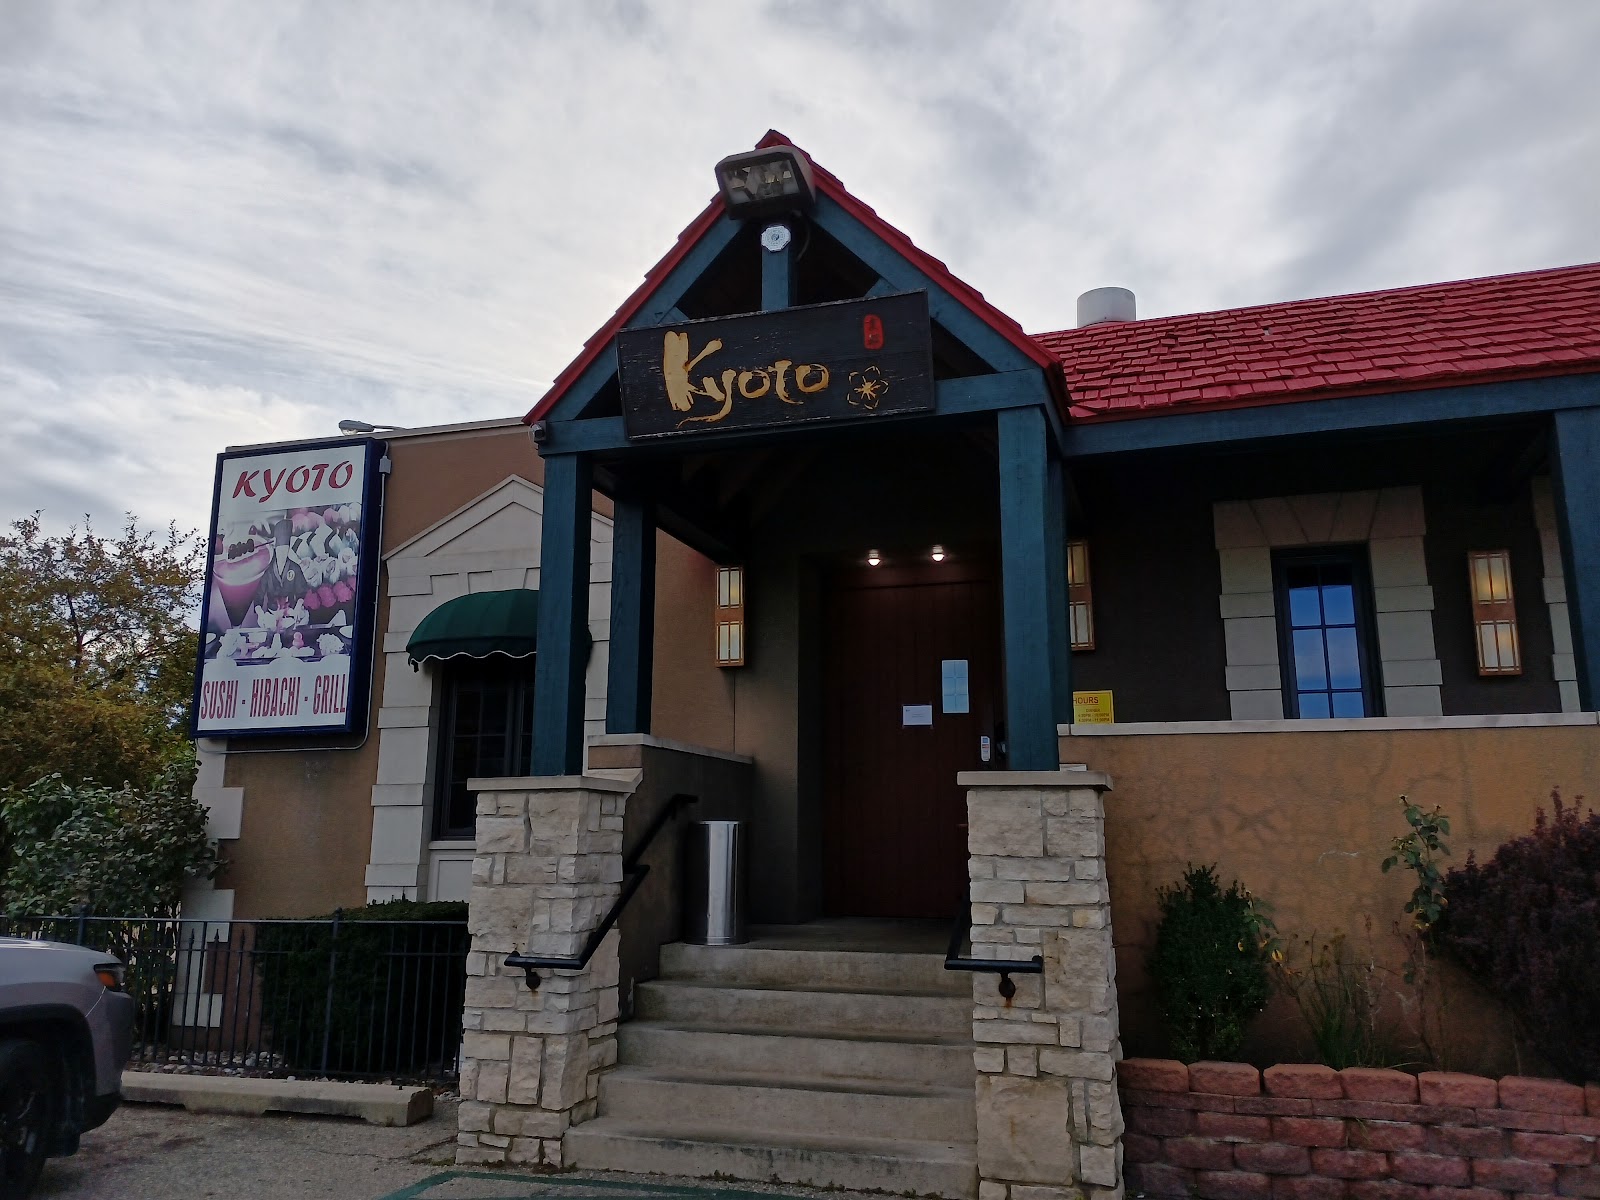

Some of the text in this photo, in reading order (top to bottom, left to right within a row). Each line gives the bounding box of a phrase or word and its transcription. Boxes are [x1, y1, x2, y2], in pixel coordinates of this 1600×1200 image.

[663, 330, 830, 428] Kyoto
[201, 680, 239, 719] SUSHI
[250, 676, 301, 717] HIBACHI
[313, 673, 346, 714] GRILL
